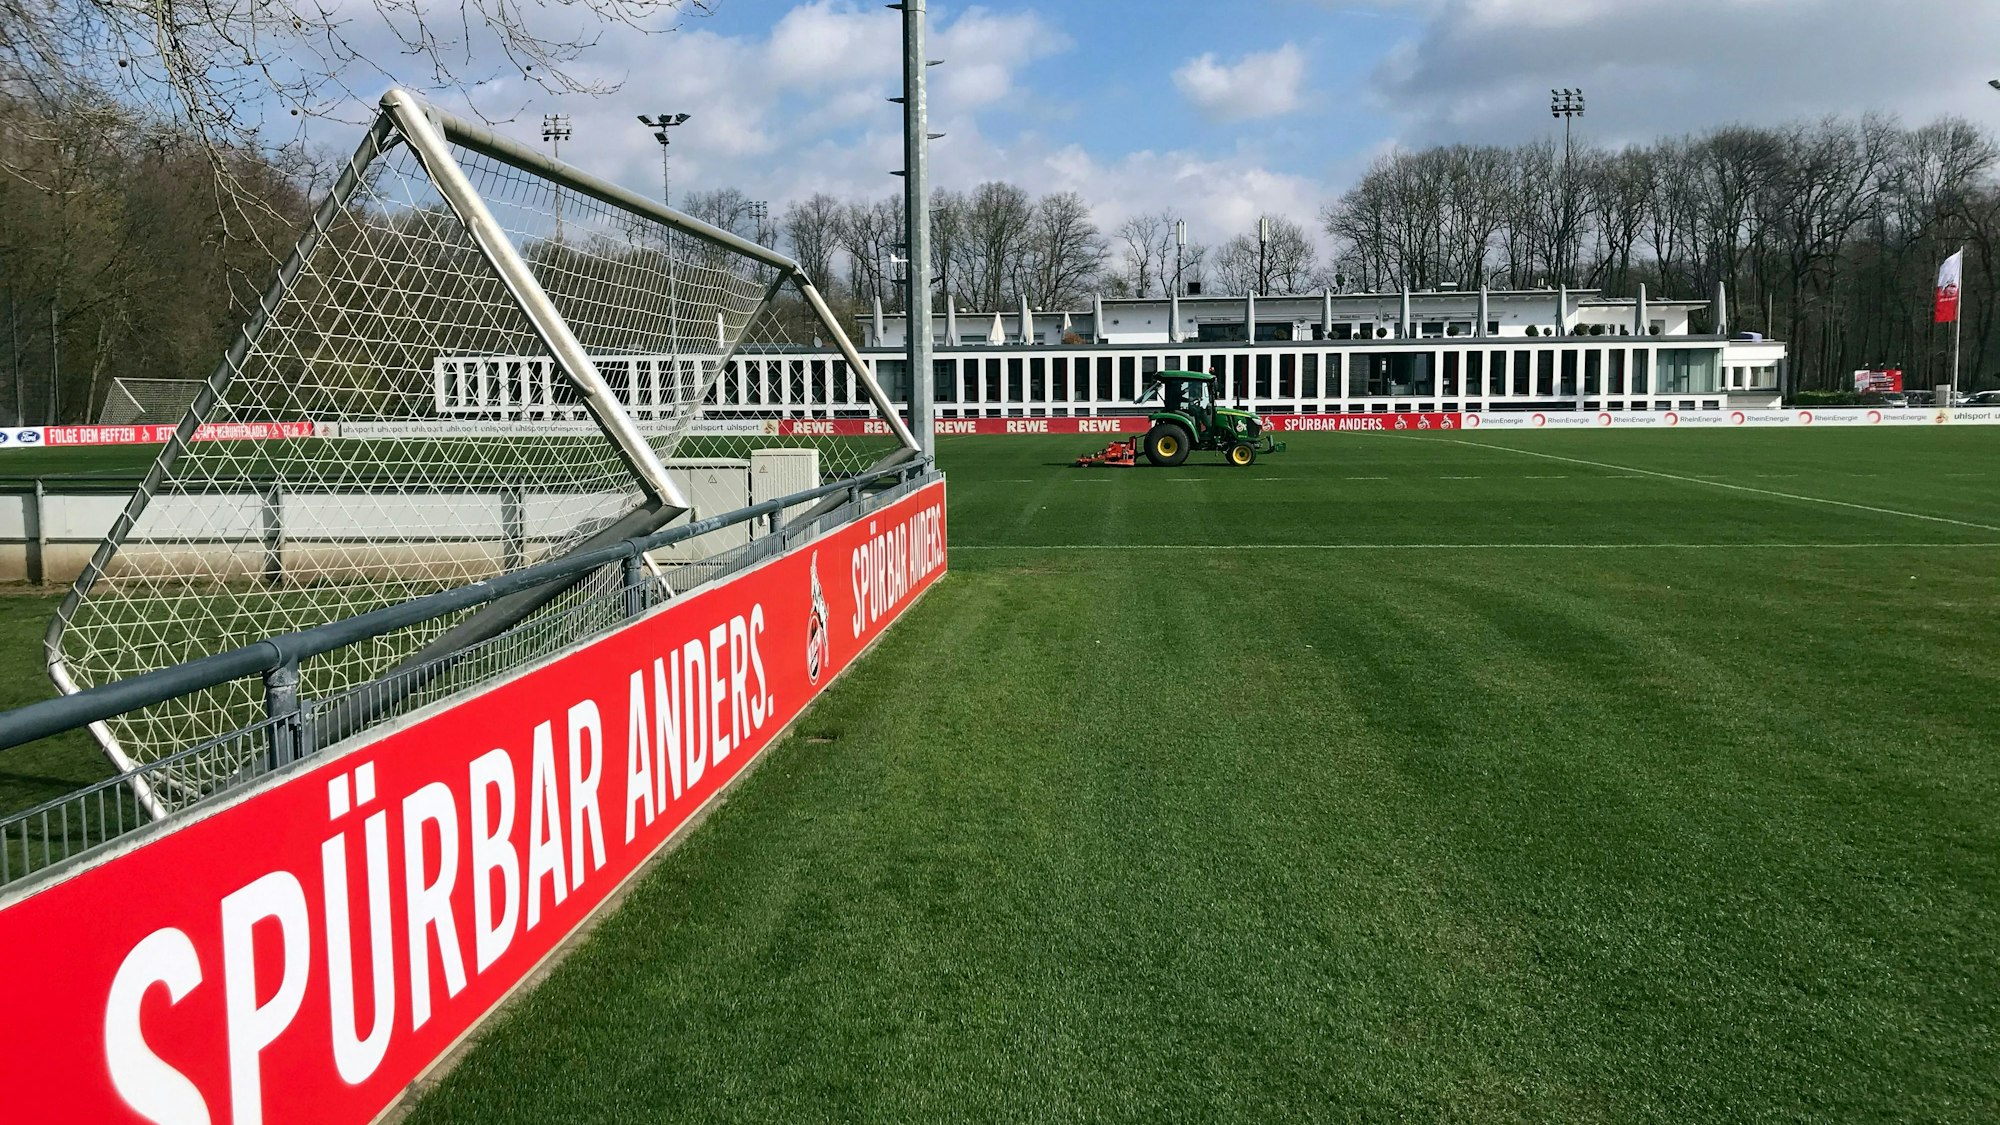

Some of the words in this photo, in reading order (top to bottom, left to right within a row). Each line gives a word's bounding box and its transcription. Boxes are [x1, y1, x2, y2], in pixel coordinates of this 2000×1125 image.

[1284, 415, 1336, 431] SPÜRBAR
[1338, 417, 1386, 430] ANDERS.
[1954, 413, 1991, 421] uhlsport
[156, 426, 176, 440] JETZ
[691, 424, 723, 432] uhlsport
[726, 424, 759, 432] uhlsport
[793, 422, 834, 434] REWE
[864, 421, 894, 433] REW
[935, 421, 976, 433] REWE
[1007, 421, 1048, 432] REWE
[1079, 420, 1120, 432] REWE
[50, 428, 77, 443] FOLGE
[80, 427, 98, 442] DEM
[100, 427, 135, 442] #EFFZEH
[852, 520, 908, 640] SPÜRBAR
[909, 502, 945, 589] ANDERS.
[105, 698, 607, 1125] SPÜRBAR
[625, 603, 775, 845] ANDERS.
